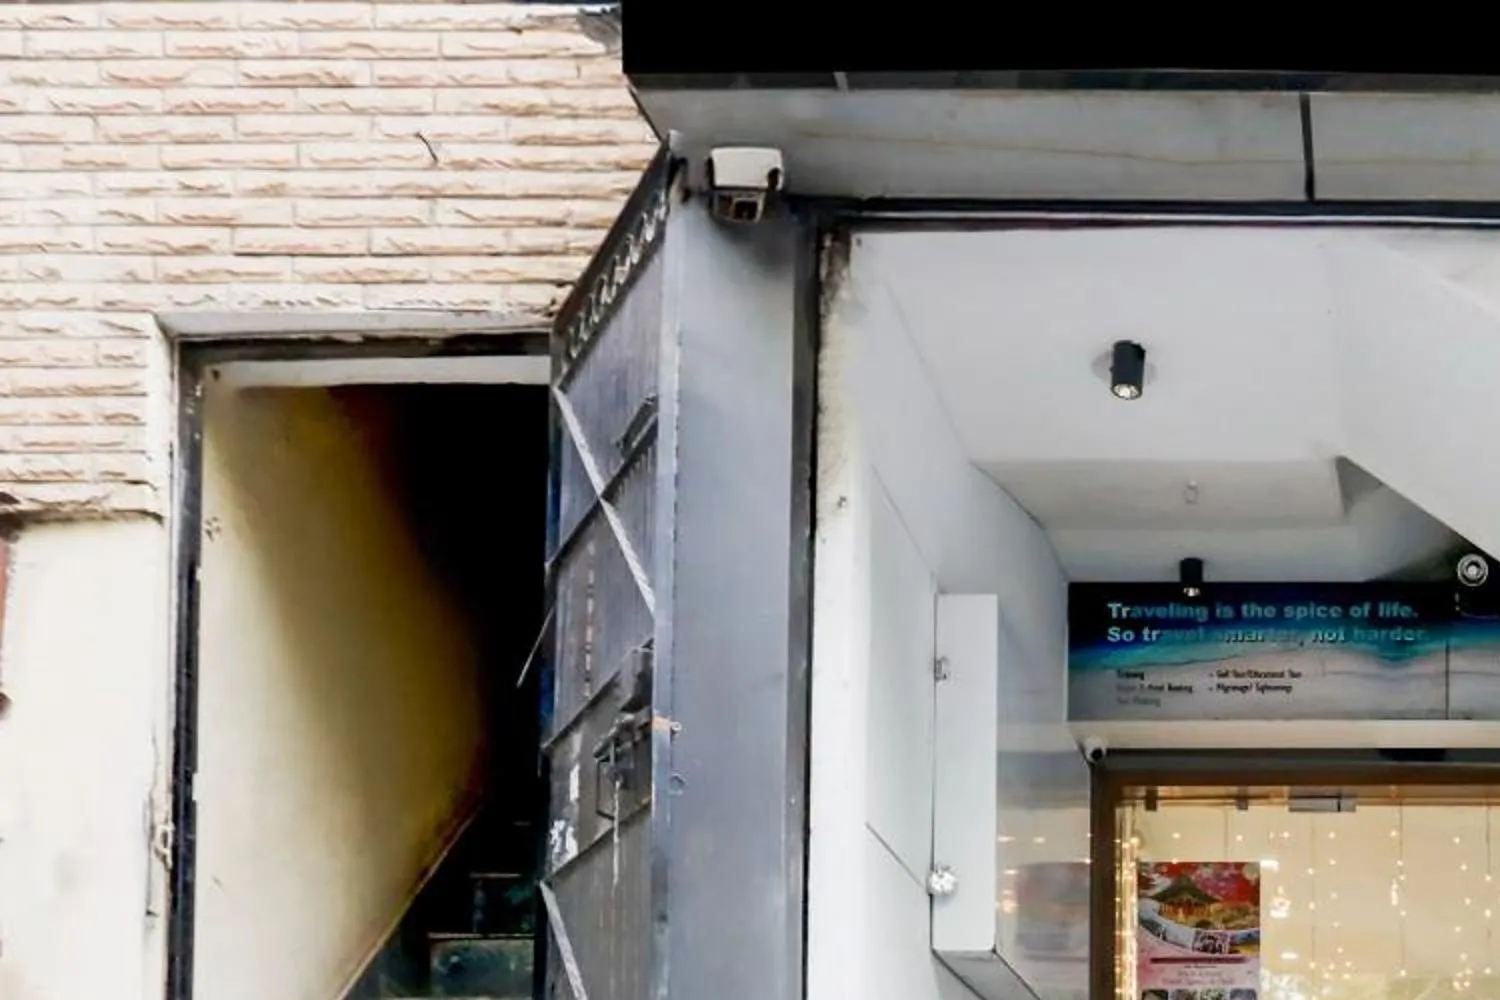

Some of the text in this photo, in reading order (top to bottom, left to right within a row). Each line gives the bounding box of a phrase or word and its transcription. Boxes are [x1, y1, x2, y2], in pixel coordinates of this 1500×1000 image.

[1107, 601, 1419, 622] Traveling is the spice of life.
[1107, 626, 1135, 642] So
[1141, 626, 1203, 642] travel
[1313, 626, 1345, 643] not
